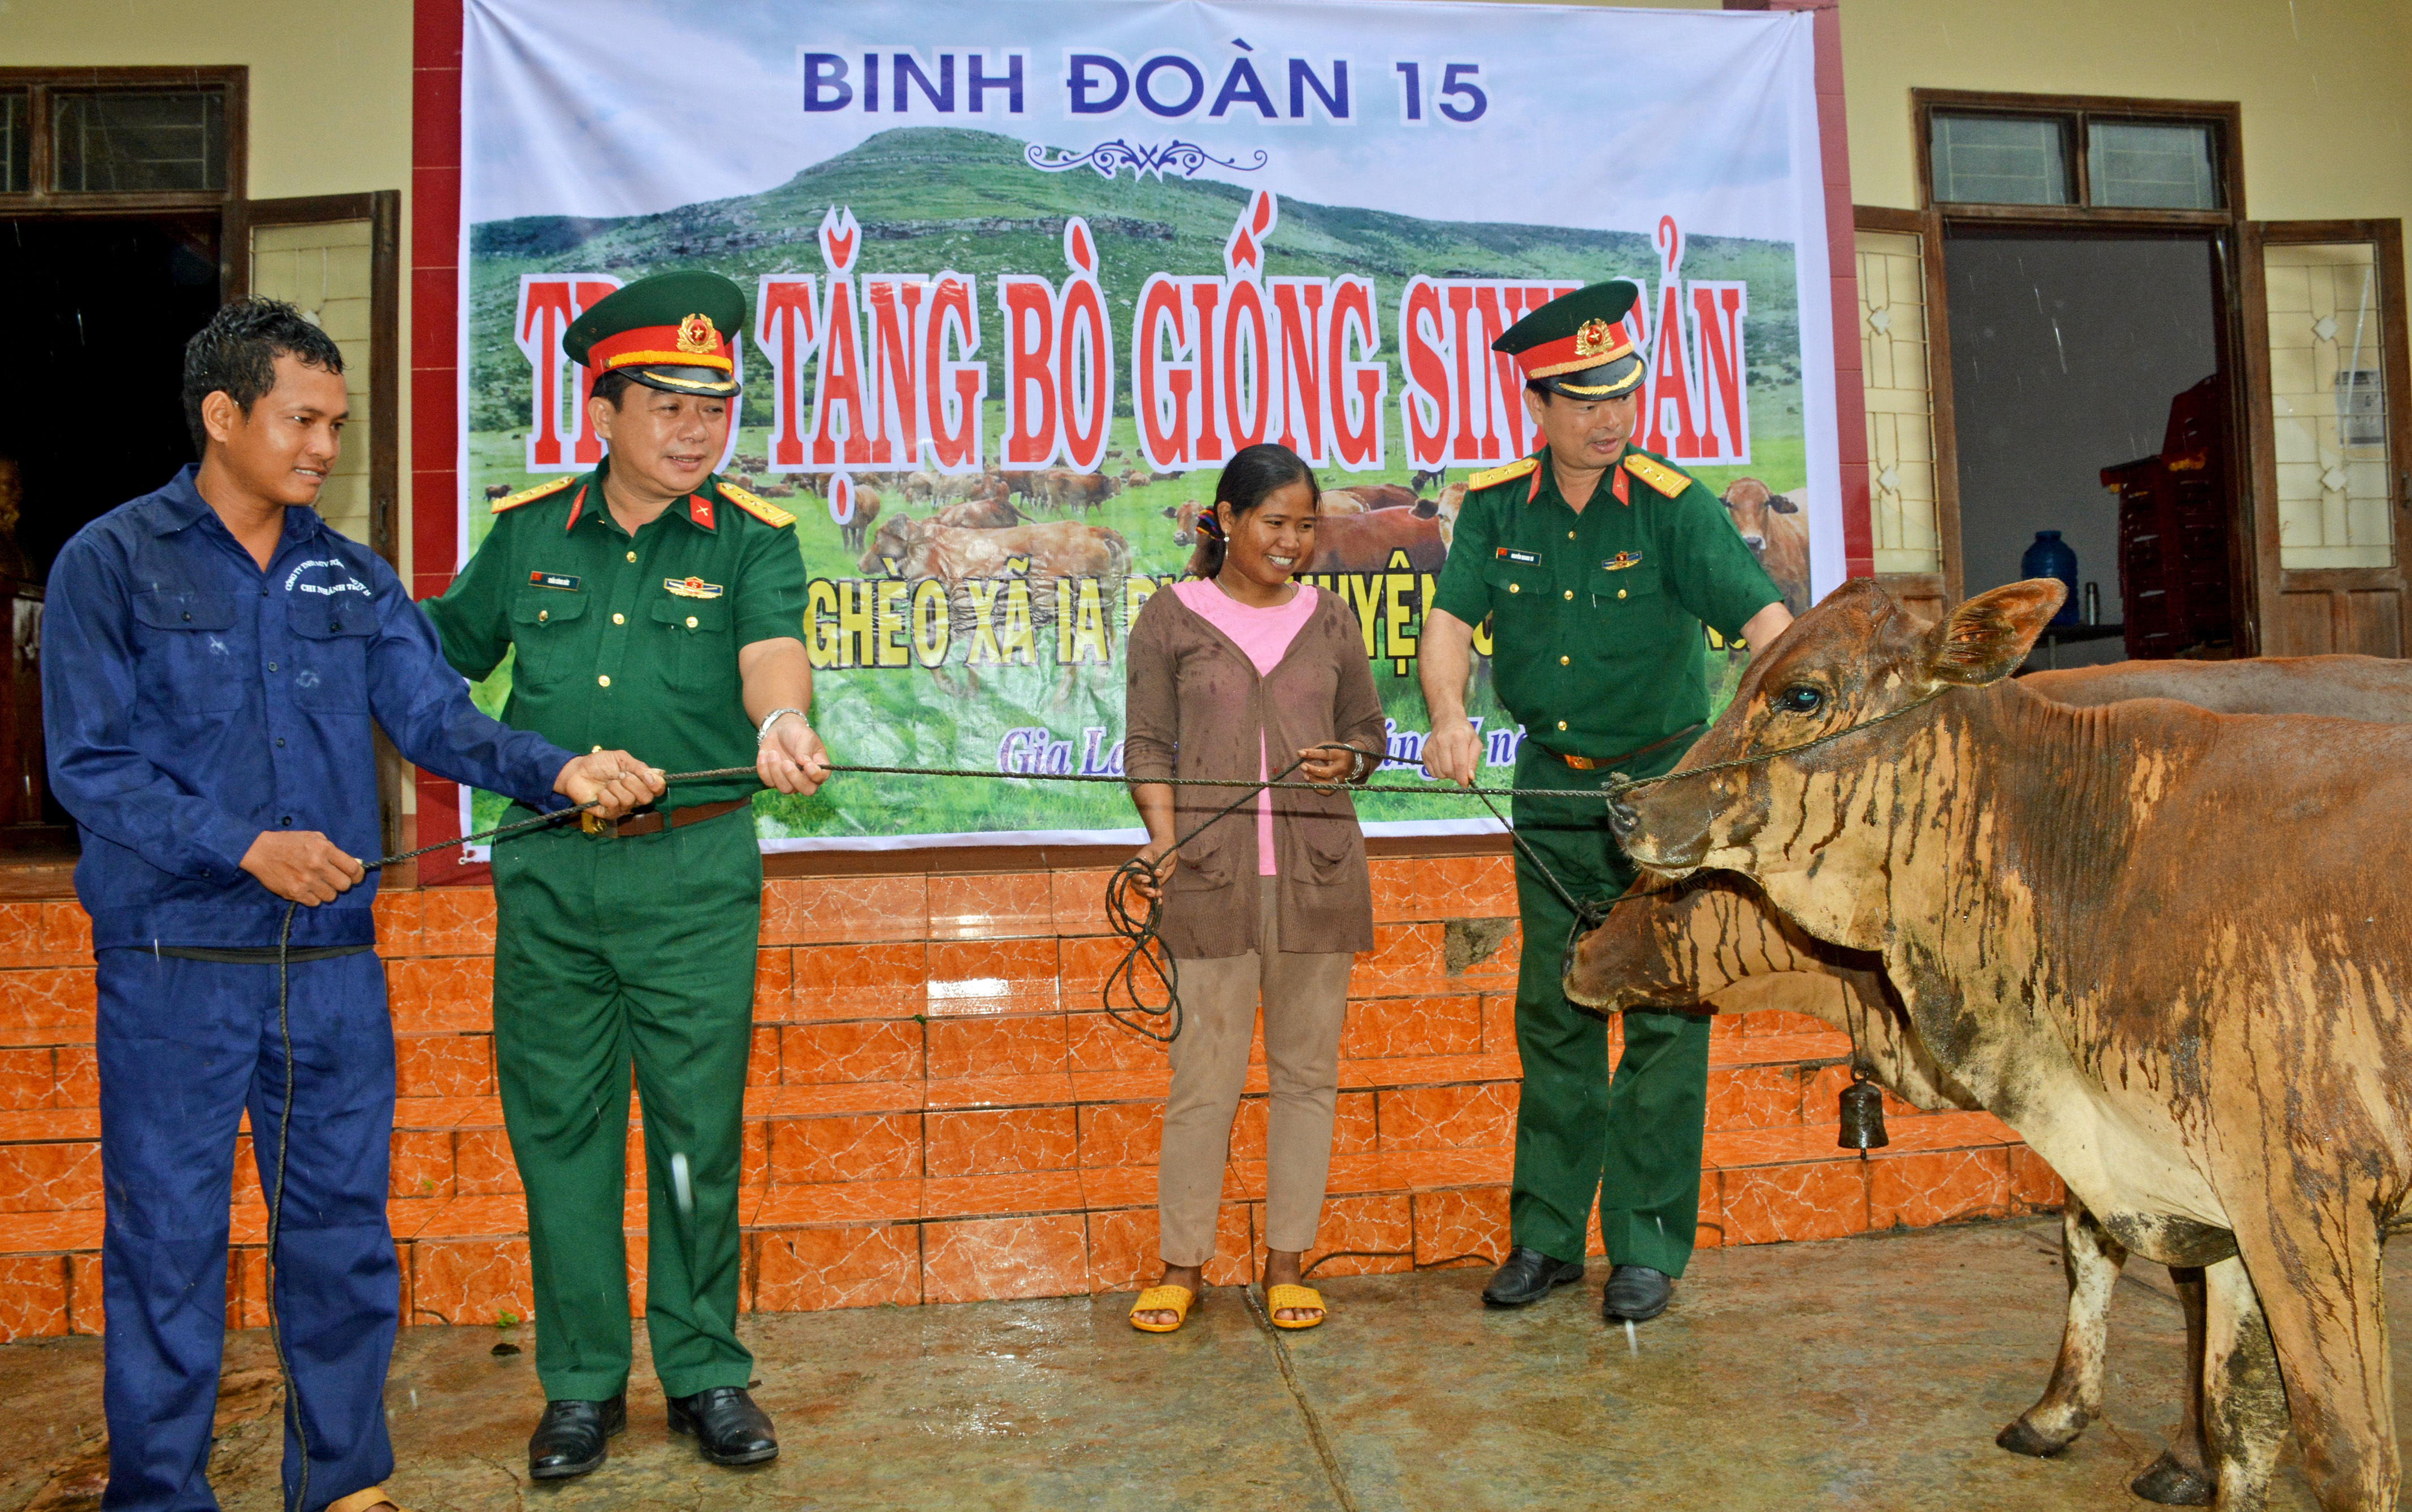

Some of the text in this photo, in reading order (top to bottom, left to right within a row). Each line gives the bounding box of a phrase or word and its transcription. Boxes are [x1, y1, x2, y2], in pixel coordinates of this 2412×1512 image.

[804, 37, 1487, 122] BINH ĐOÀN 15
[763, 226, 980, 516] TẶNG
[1006, 224, 1106, 467] BÒ
[1139, 190, 1380, 466] GIỐNG
[1623, 215, 1743, 459] ẢN
[293, 566, 303, 575] TY
[300, 584, 316, 593] CHI
[803, 557, 950, 667] GHÈO
[966, 557, 1036, 665] XÃ
[1057, 577, 1108, 663] IA
[1000, 731, 1070, 776] Gia
